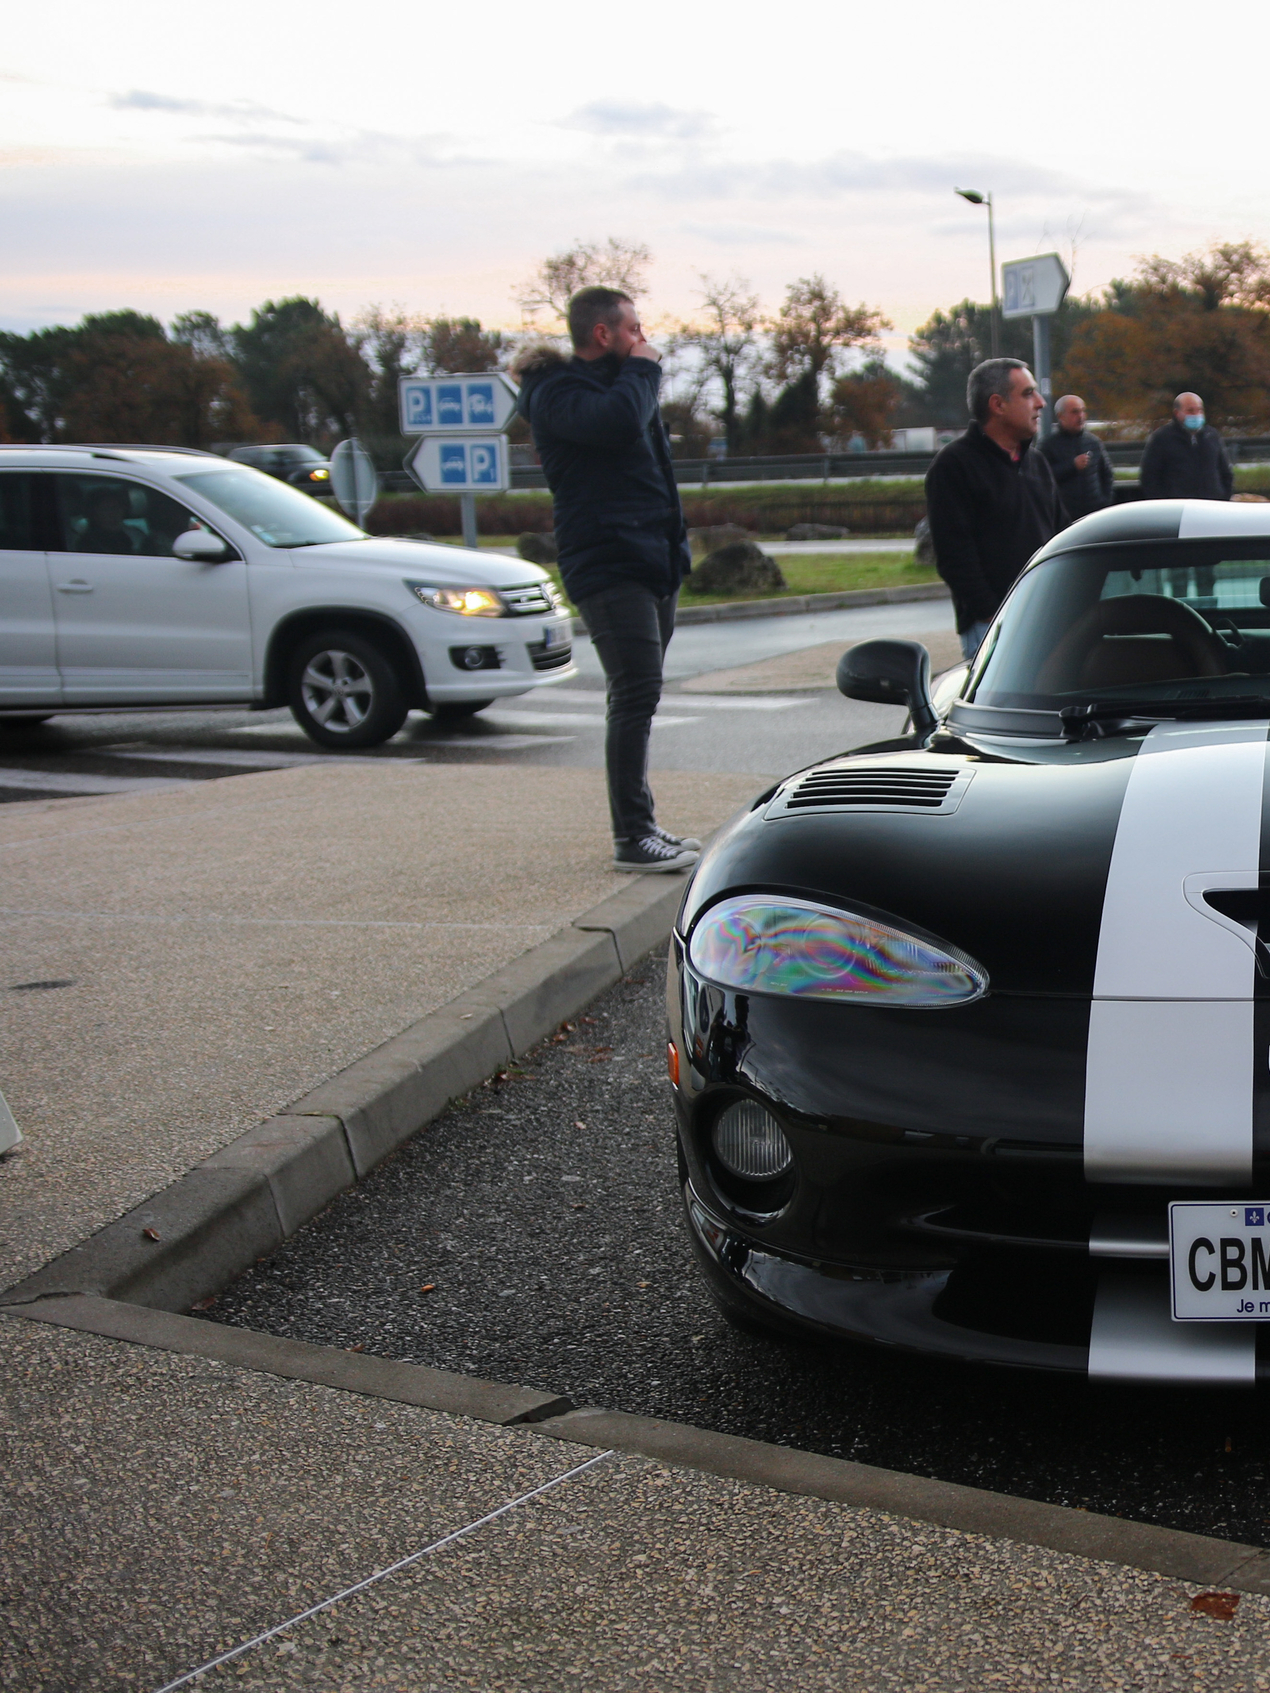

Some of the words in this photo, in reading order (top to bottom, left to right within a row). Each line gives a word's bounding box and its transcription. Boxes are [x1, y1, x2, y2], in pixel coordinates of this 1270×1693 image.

[407, 389, 425, 423] P
[473, 447, 490, 482] P
[1237, 1299, 1254, 1313] Je
